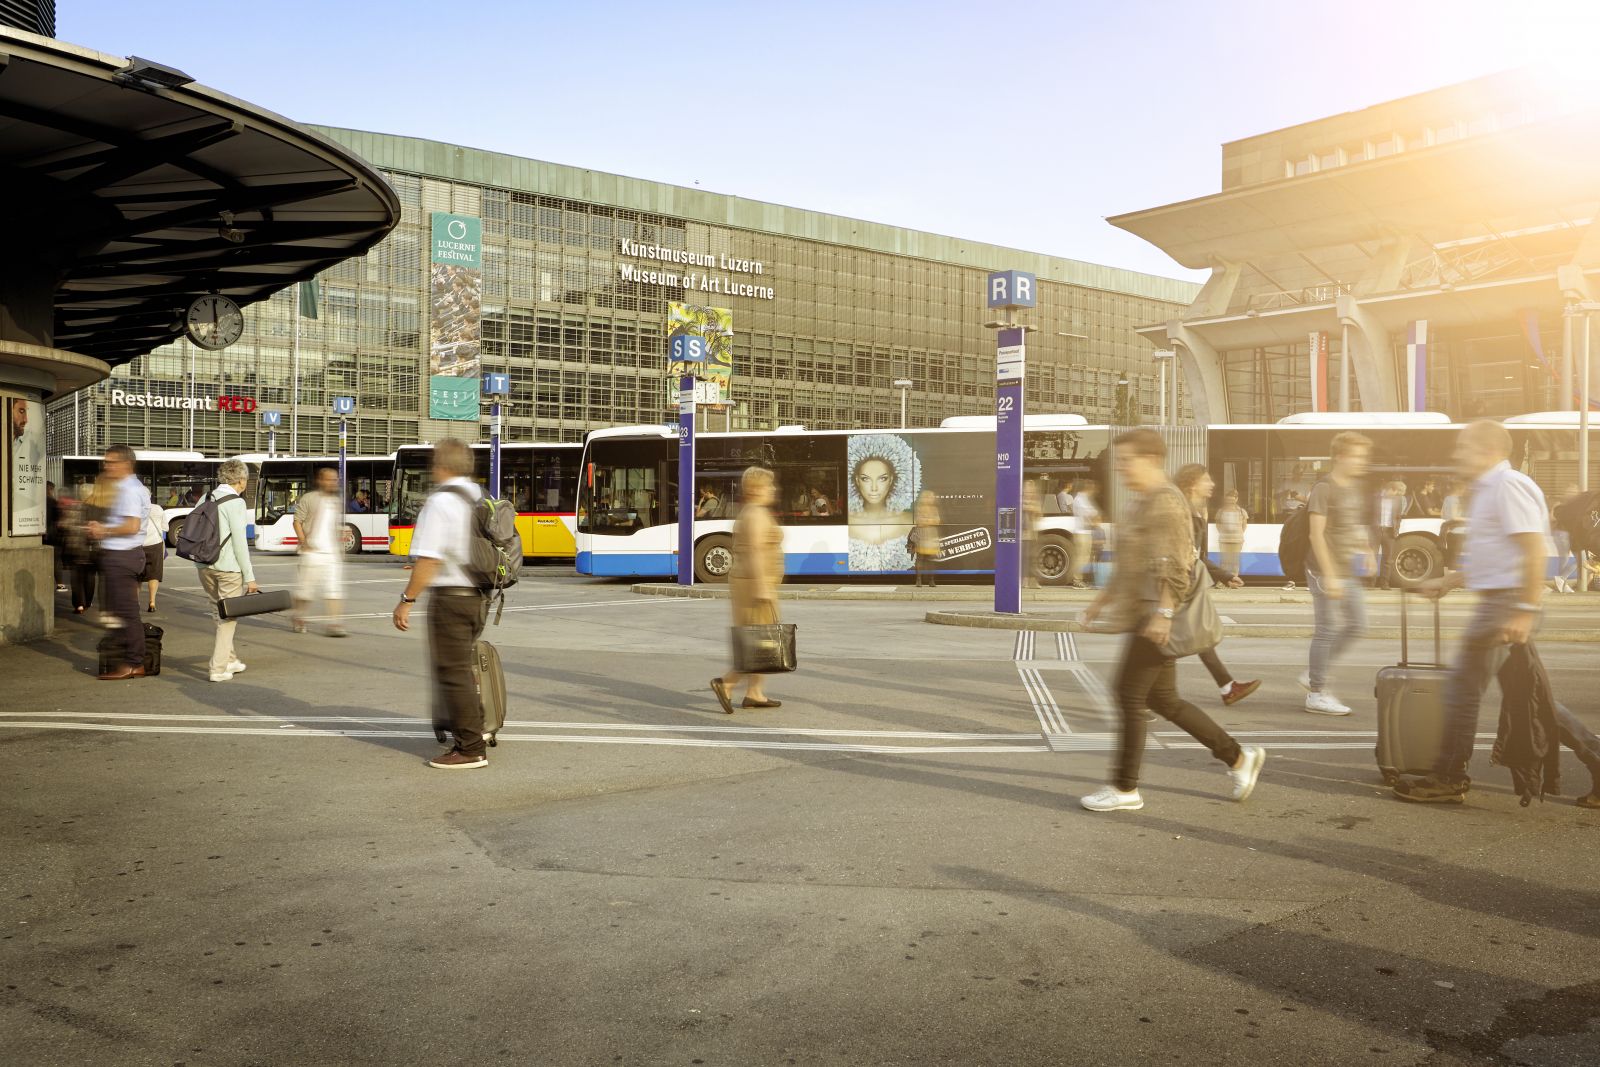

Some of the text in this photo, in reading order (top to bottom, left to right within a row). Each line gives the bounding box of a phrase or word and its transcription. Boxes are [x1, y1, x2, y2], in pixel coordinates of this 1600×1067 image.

[438, 240, 476, 252] LUCERNE
[438, 249, 475, 262] FESTIVAL
[621, 238, 762, 275] Kunstmuseum Luzern
[621, 264, 774, 300] Museum of Art Lucerne
[993, 277, 1006, 300] R
[1017, 277, 1030, 300] R
[674, 340, 682, 357] S
[689, 340, 700, 357] S
[495, 377, 505, 390] T
[111, 389, 257, 413] Restaurant RED
[340, 399, 350, 411] U
[999, 397, 1013, 411] 22
[269, 412, 278, 423] V
[997, 453, 1009, 462] N10
[948, 539, 987, 555] WERBUNG
